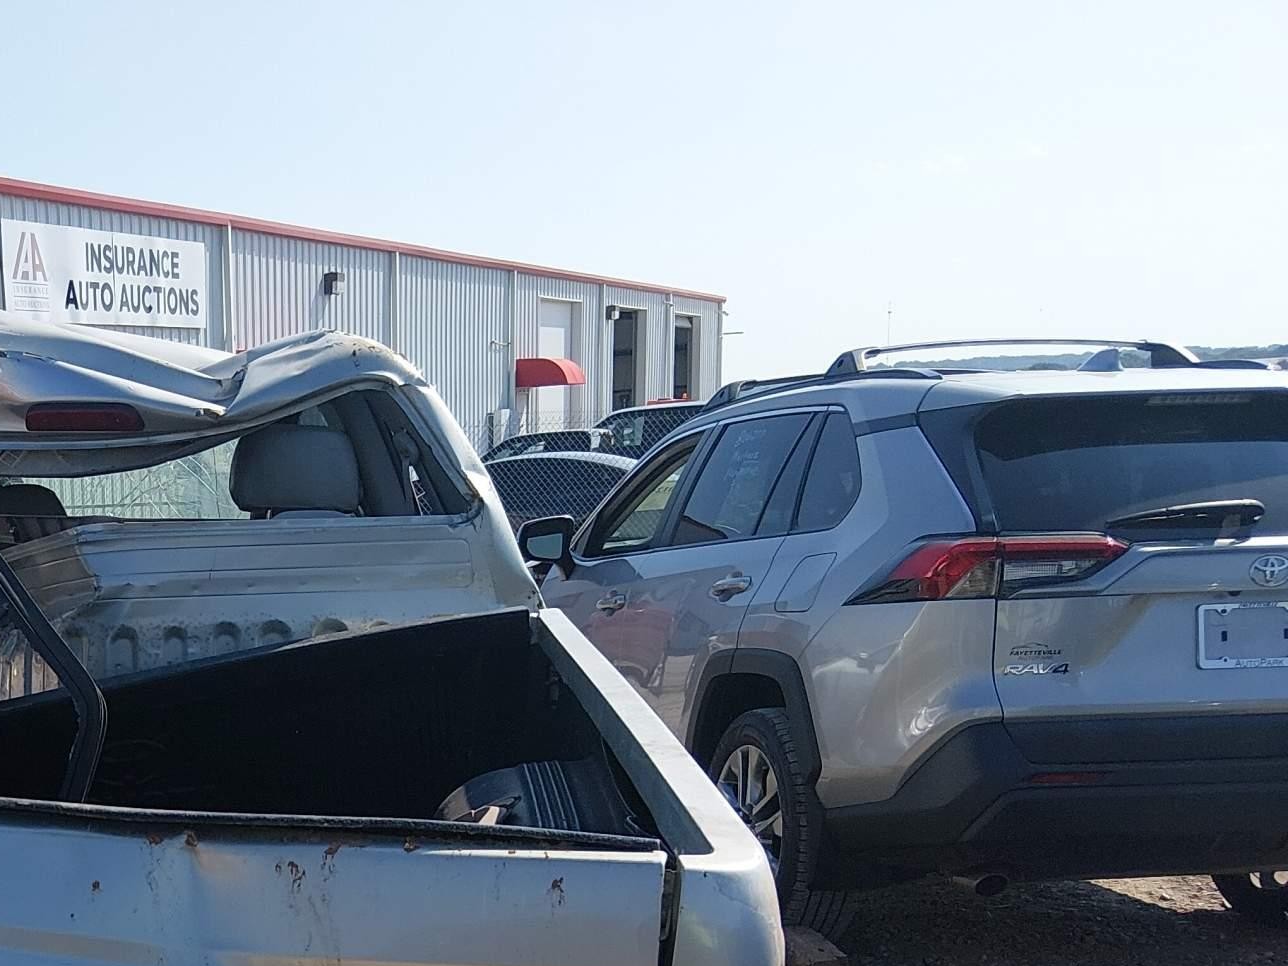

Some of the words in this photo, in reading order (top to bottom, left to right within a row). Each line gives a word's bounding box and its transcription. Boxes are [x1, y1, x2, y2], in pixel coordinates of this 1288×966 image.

[85, 242, 180, 280] INSURANCE
[65, 279, 112, 312] AUTO
[120, 283, 200, 317] AUCTIONS
[1003, 663, 1070, 675] RAV4
